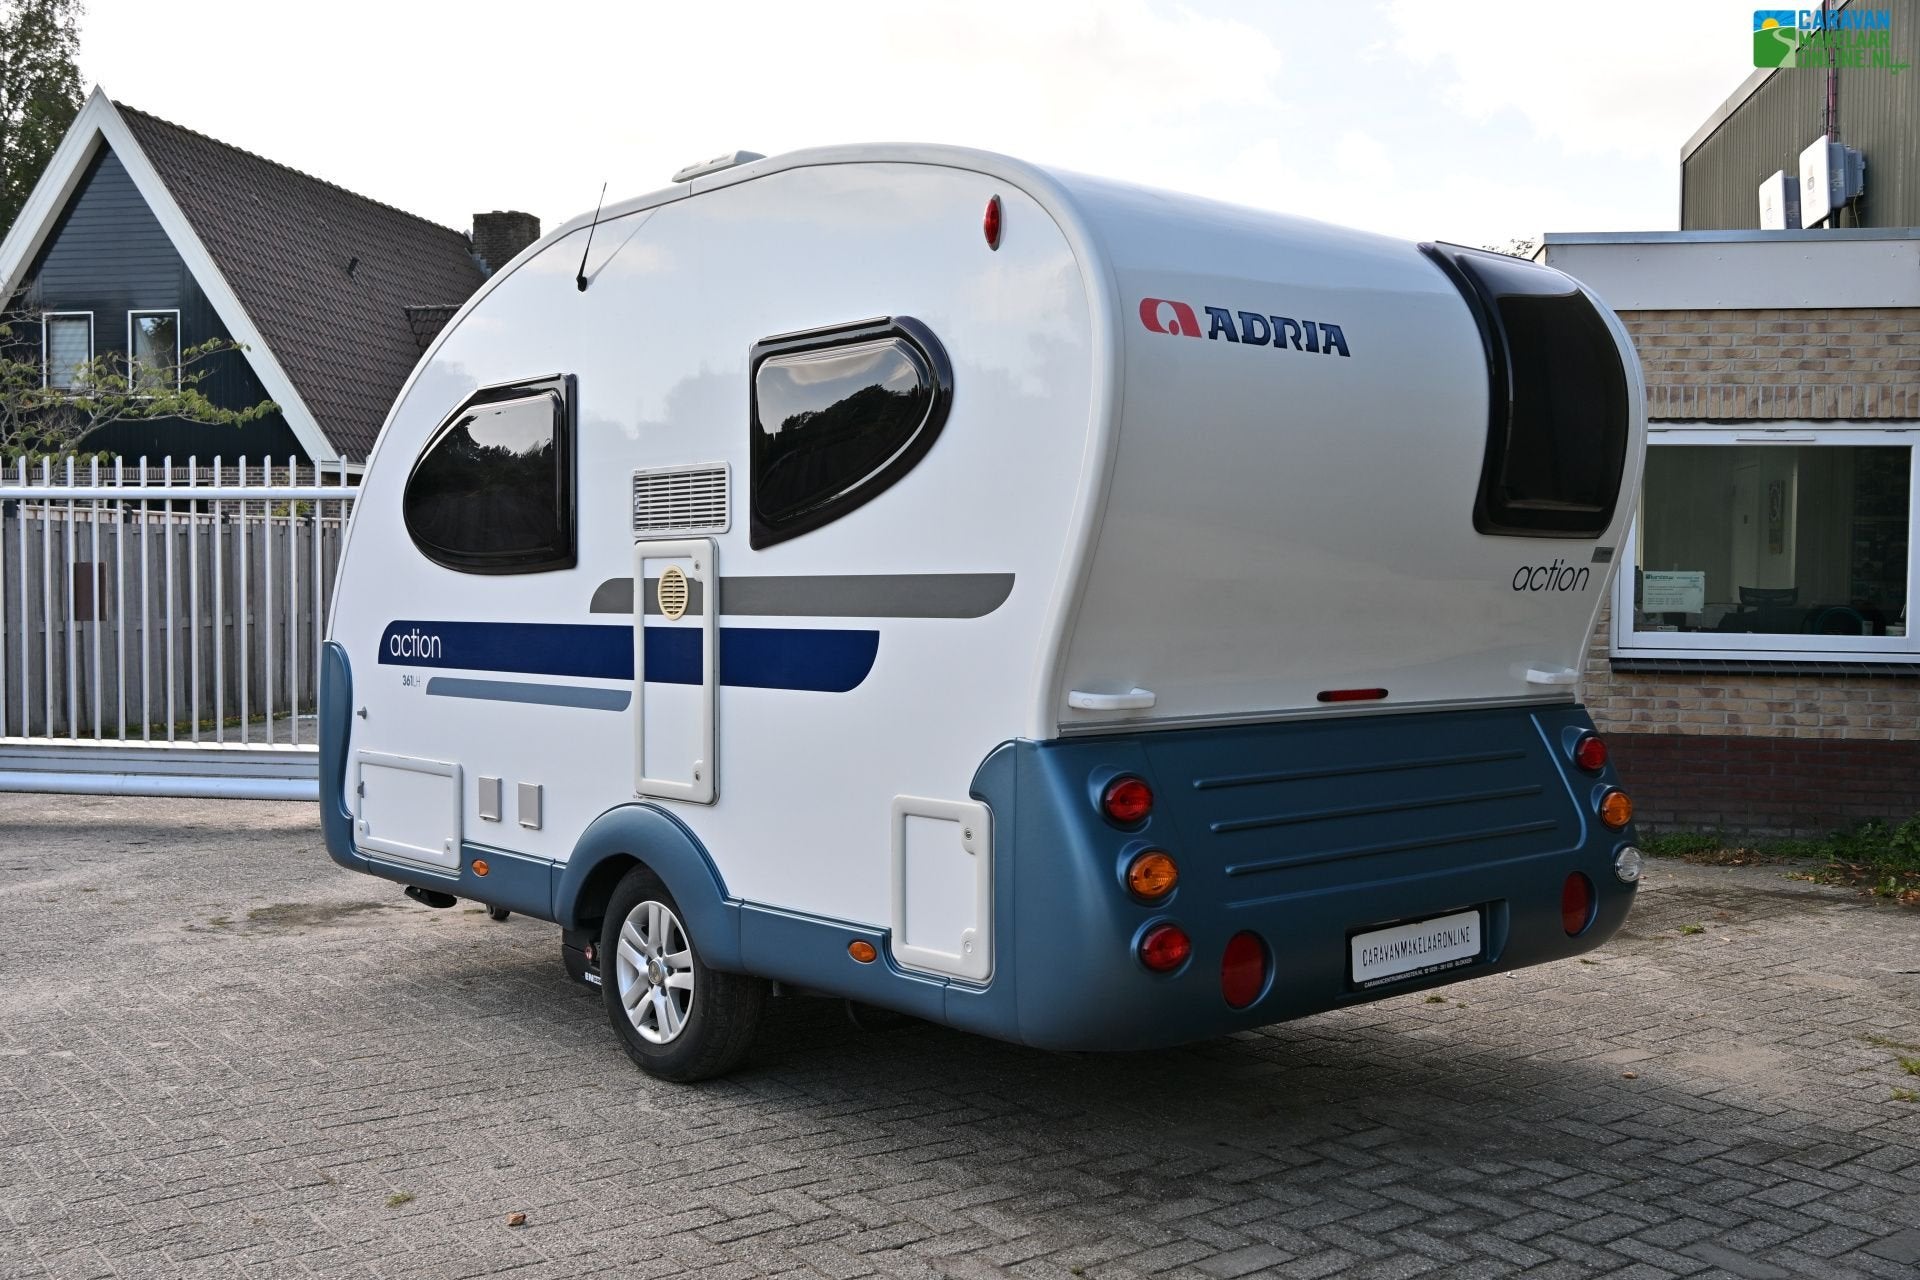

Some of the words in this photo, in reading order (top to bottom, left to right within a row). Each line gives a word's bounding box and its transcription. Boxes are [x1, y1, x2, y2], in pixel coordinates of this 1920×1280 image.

[1204, 305, 1351, 358] ADRIA
[1512, 558, 1590, 592] action
[390, 627, 442, 659] action
[1362, 926, 1471, 967] CARAVANMAKELAARONLINE
